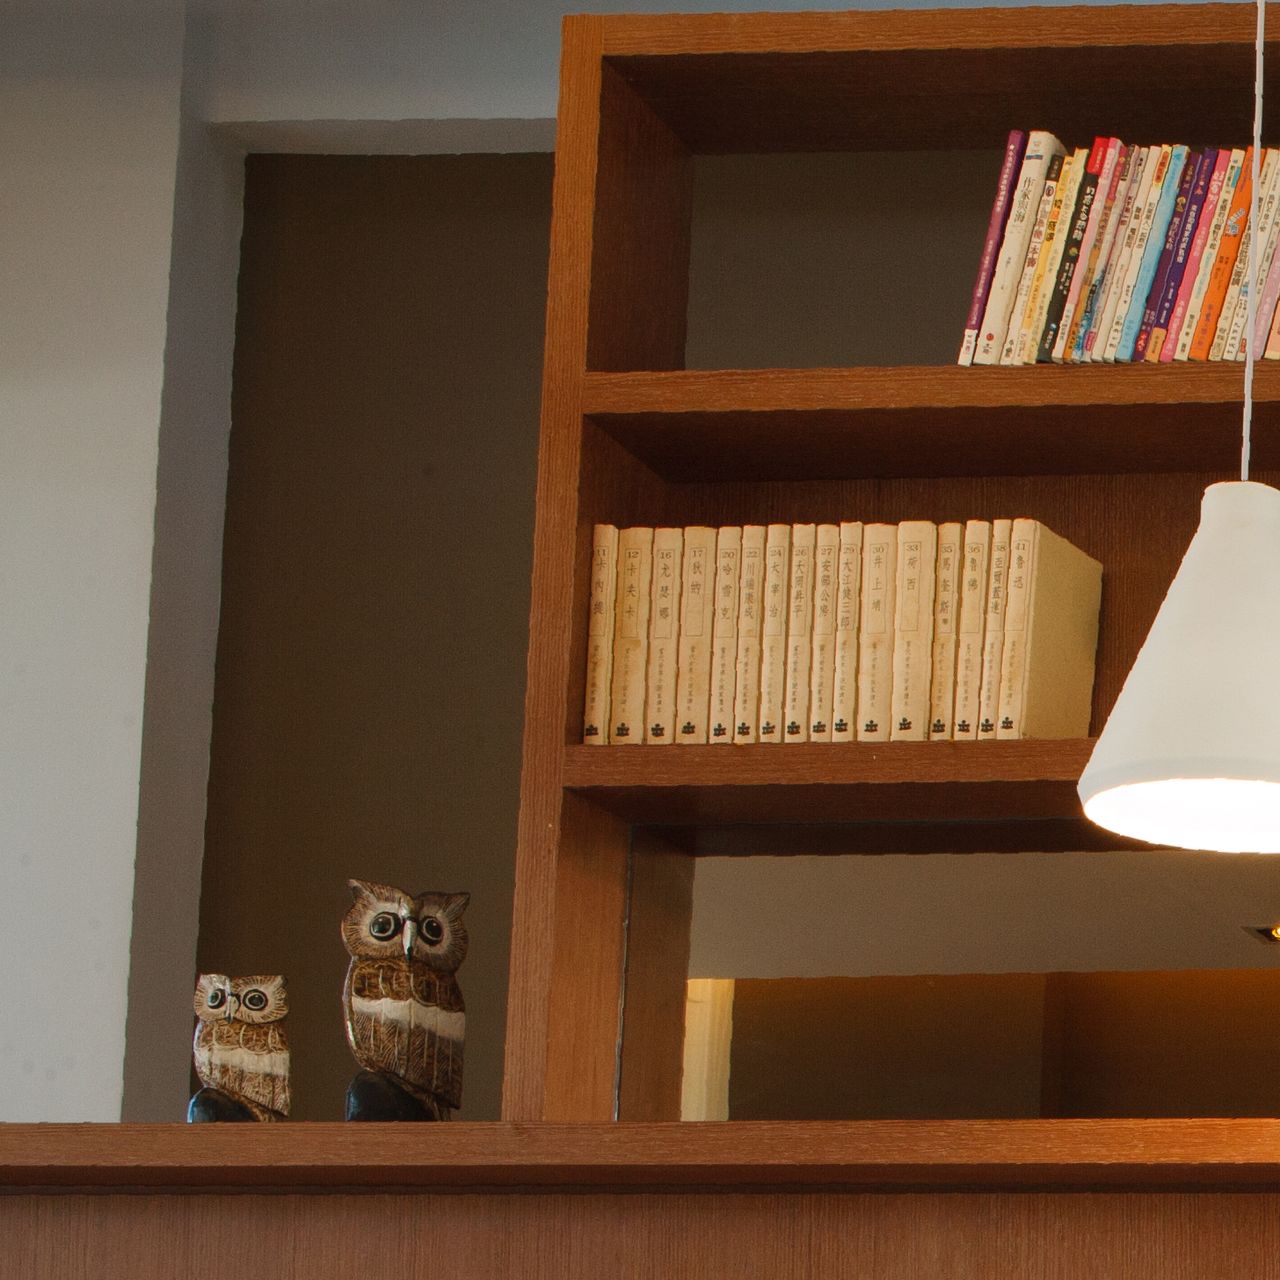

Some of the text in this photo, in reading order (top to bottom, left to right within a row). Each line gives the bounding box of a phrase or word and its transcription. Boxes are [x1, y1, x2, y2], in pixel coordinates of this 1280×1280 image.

[794, 548, 807, 556] 26
[820, 547, 832, 555] 27
[872, 545, 884, 553] 30
[906, 544, 919, 552] 33
[626, 551, 639, 559] 12
[659, 551, 672, 559] 16
[721, 551, 734, 559] 20
[770, 549, 782, 557] 24
[819, 559, 831, 617] 安部公房
[871, 557, 883, 612] 井上靖
[626, 562, 637, 619] 卡夫卡
[743, 563, 755, 619] 川端康成
[769, 561, 781, 618] 太宰治
[840, 559, 853, 627] 大江健三郎
